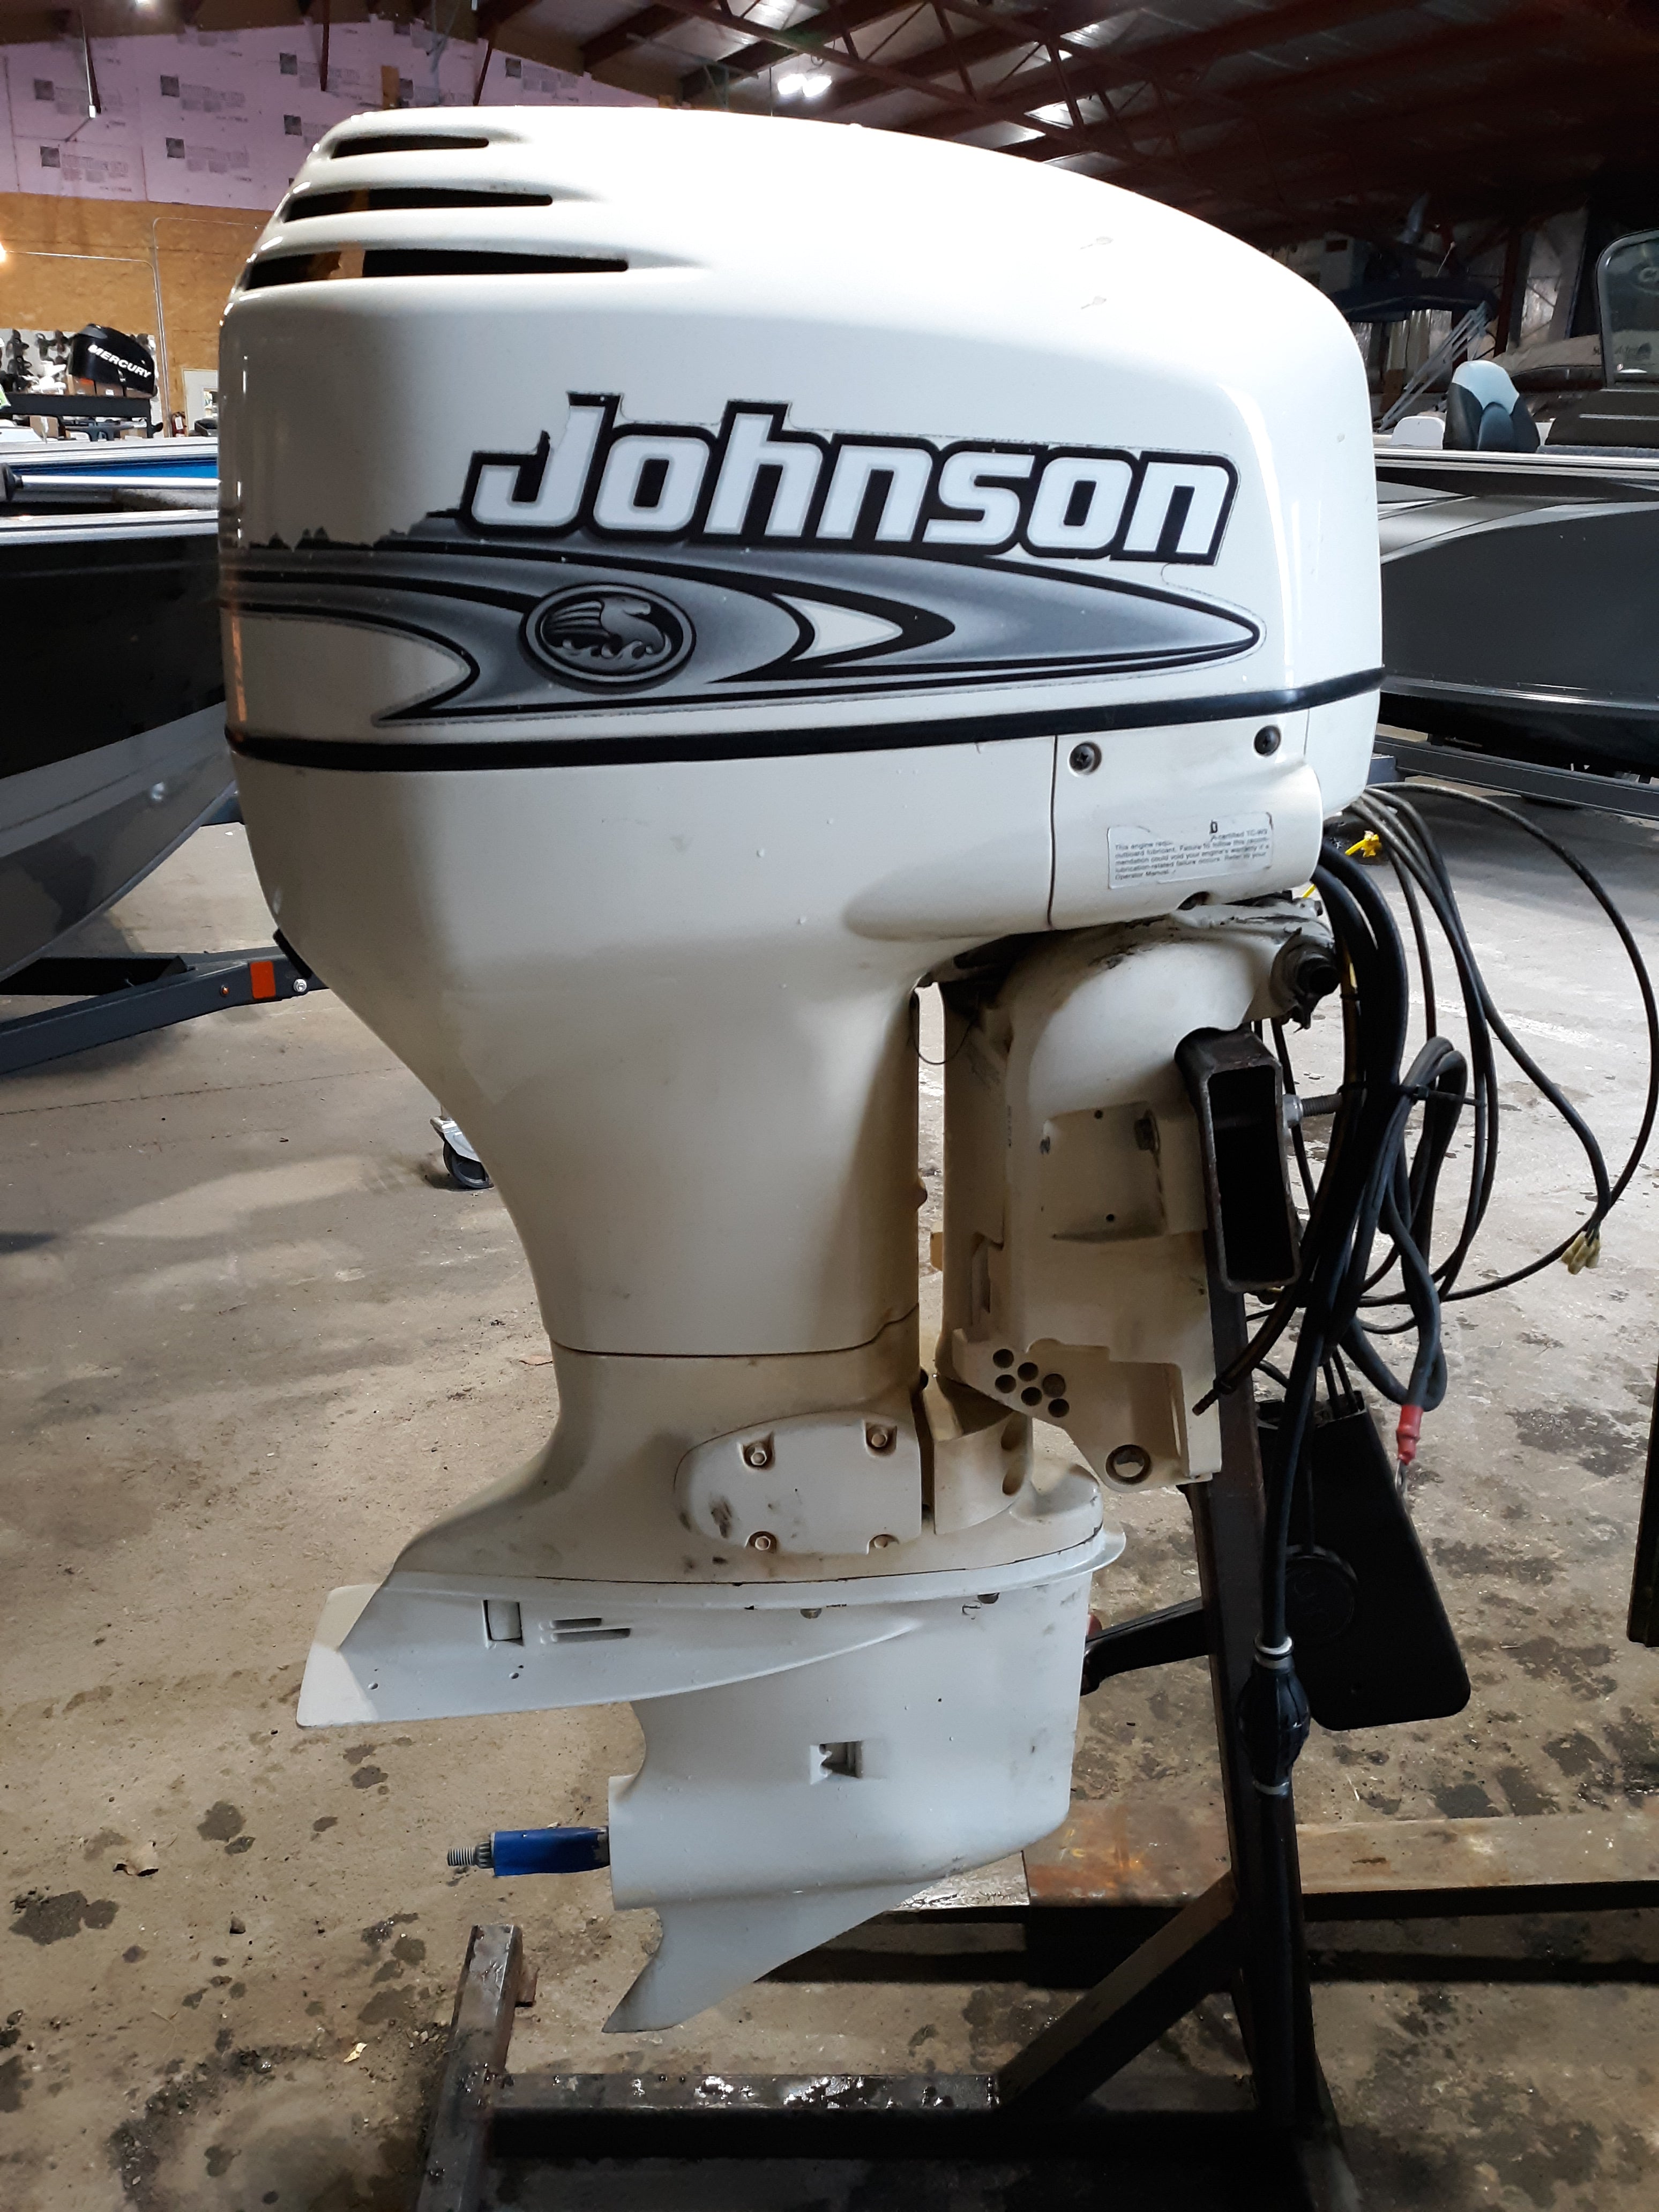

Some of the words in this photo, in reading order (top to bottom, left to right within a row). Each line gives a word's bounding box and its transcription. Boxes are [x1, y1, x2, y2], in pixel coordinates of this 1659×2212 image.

[88, 344, 152, 378] MERCURY
[465, 391, 1237, 565] Johnson
[1131, 842, 1153, 850] engine
[1231, 845, 1258, 853] warranty
[1115, 850, 1145, 858] outboard
